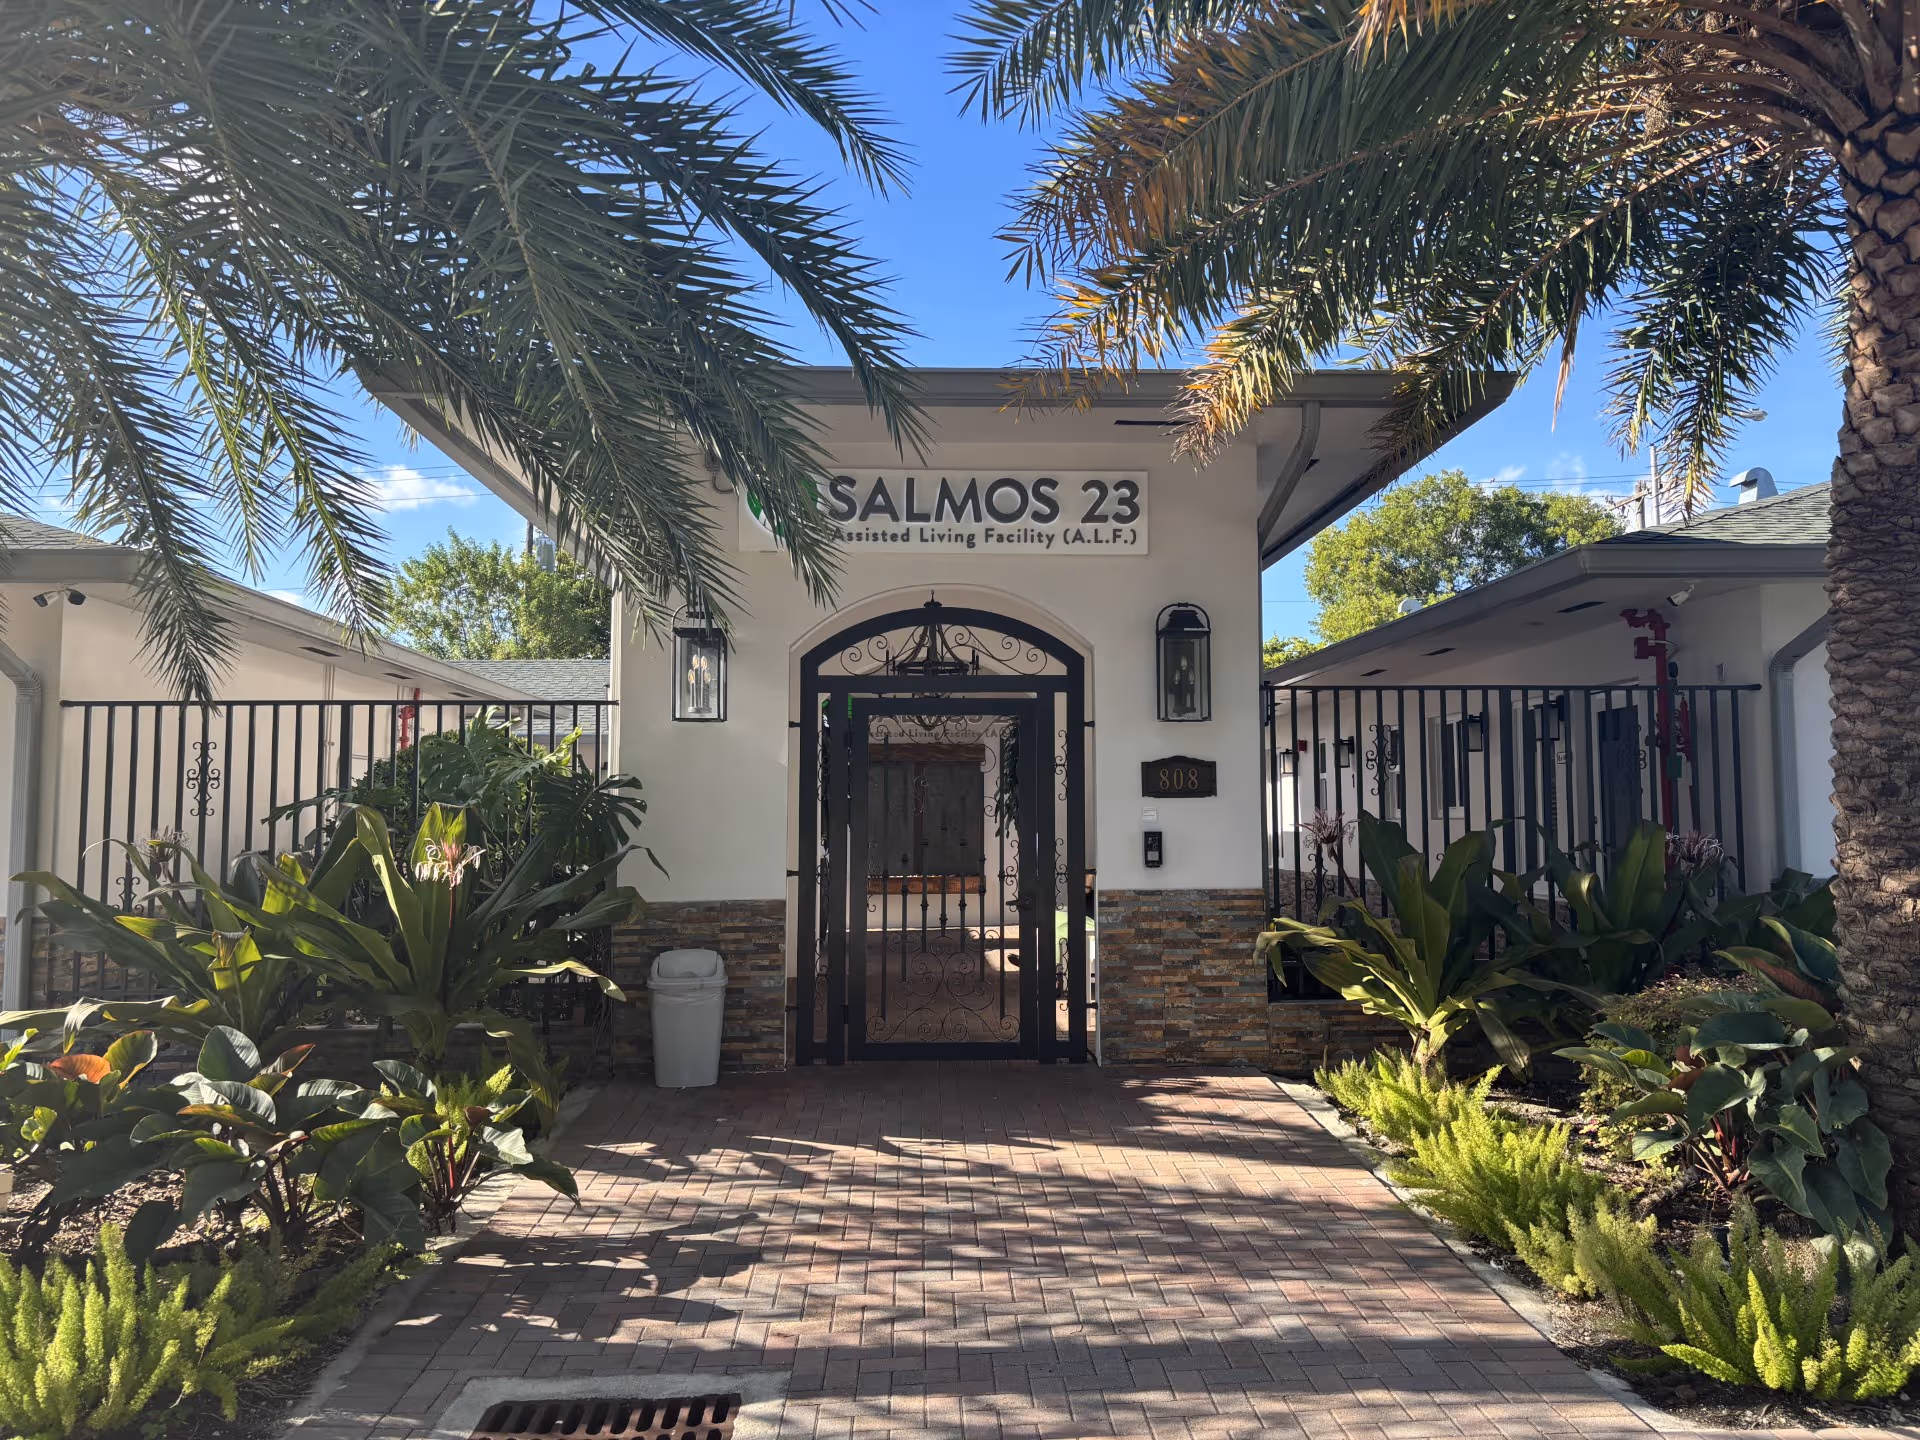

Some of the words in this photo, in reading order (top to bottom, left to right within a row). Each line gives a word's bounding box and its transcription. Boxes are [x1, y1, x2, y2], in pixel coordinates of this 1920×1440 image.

[828, 475, 1060, 524] SALMOS
[1081, 479, 1140, 524] 23
[832, 527, 911, 544] Assisted
[919, 527, 976, 548] Living
[985, 528, 1055, 548] Facility
[1063, 528, 1138, 545] (A.L.F.)
[909, 728, 940, 740] Living
[1159, 768, 1199, 790] 808
